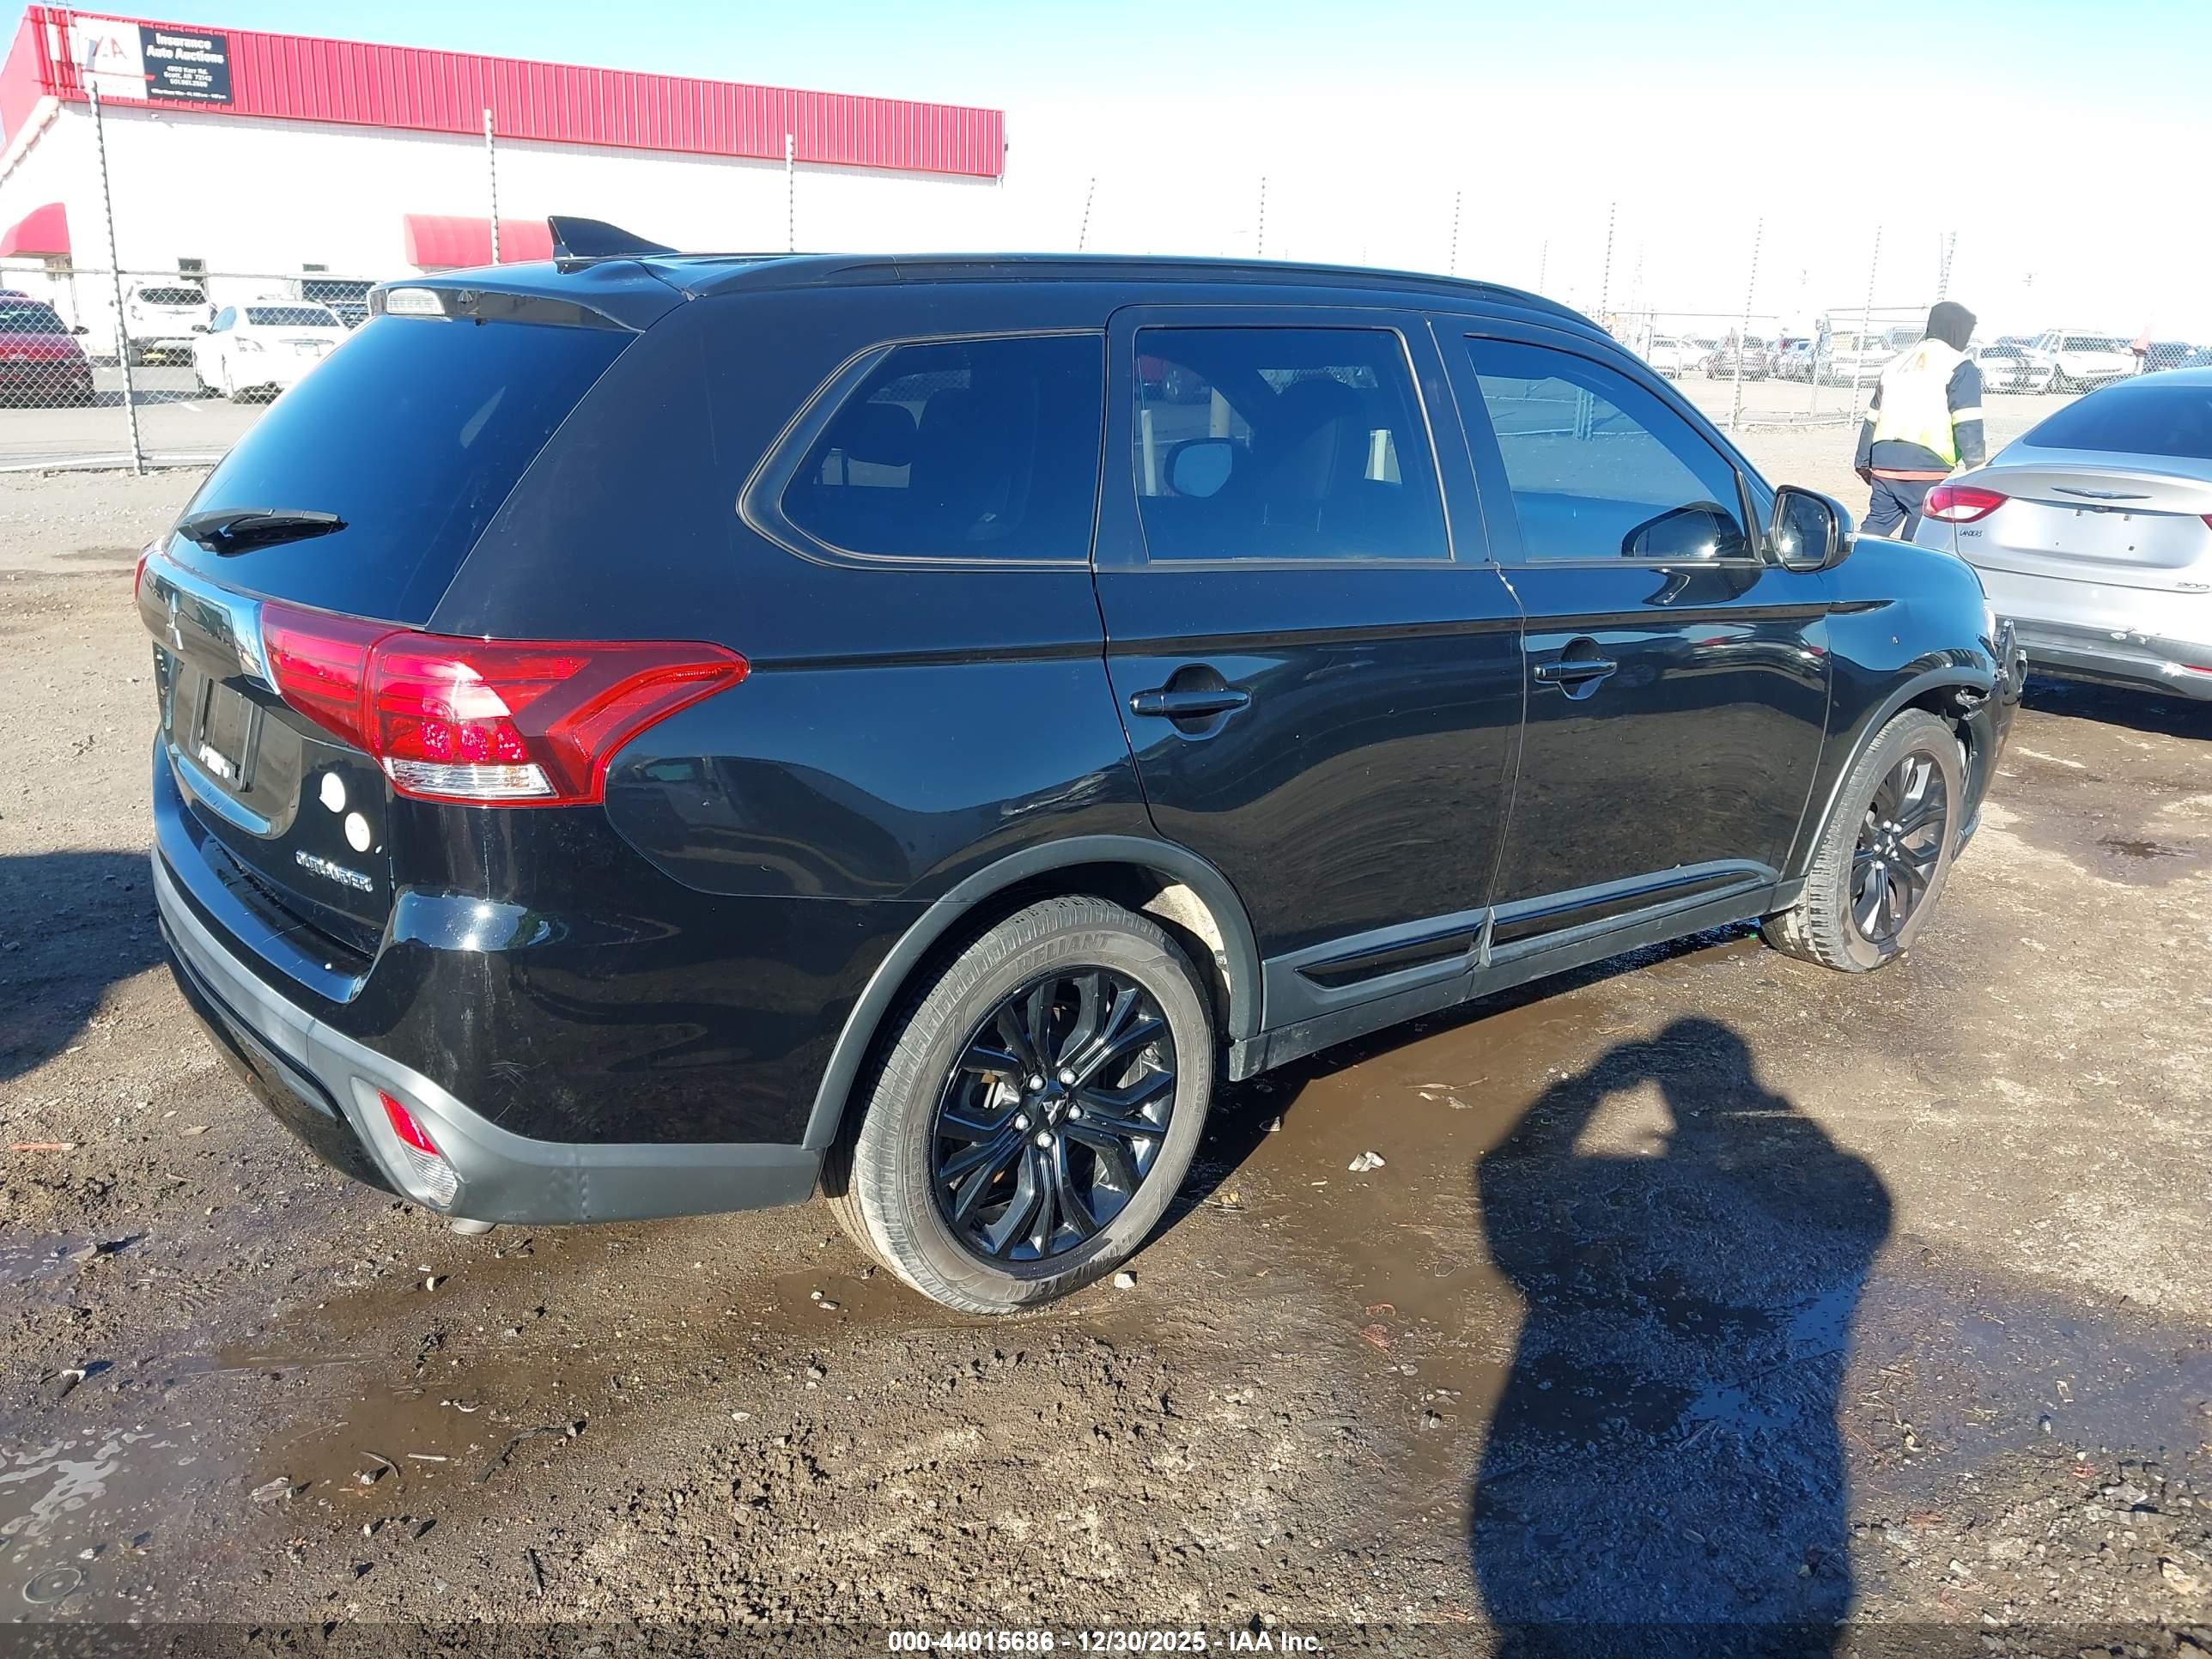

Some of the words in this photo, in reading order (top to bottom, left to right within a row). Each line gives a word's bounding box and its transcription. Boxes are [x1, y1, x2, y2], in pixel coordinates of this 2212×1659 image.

[146, 45, 173, 58] Auto
[174, 47, 224, 64] Auctions
[155, 33, 212, 50] Insurance
[295, 850, 373, 892] OUTLANDER
[1015, 933, 1115, 976] RELIANT
